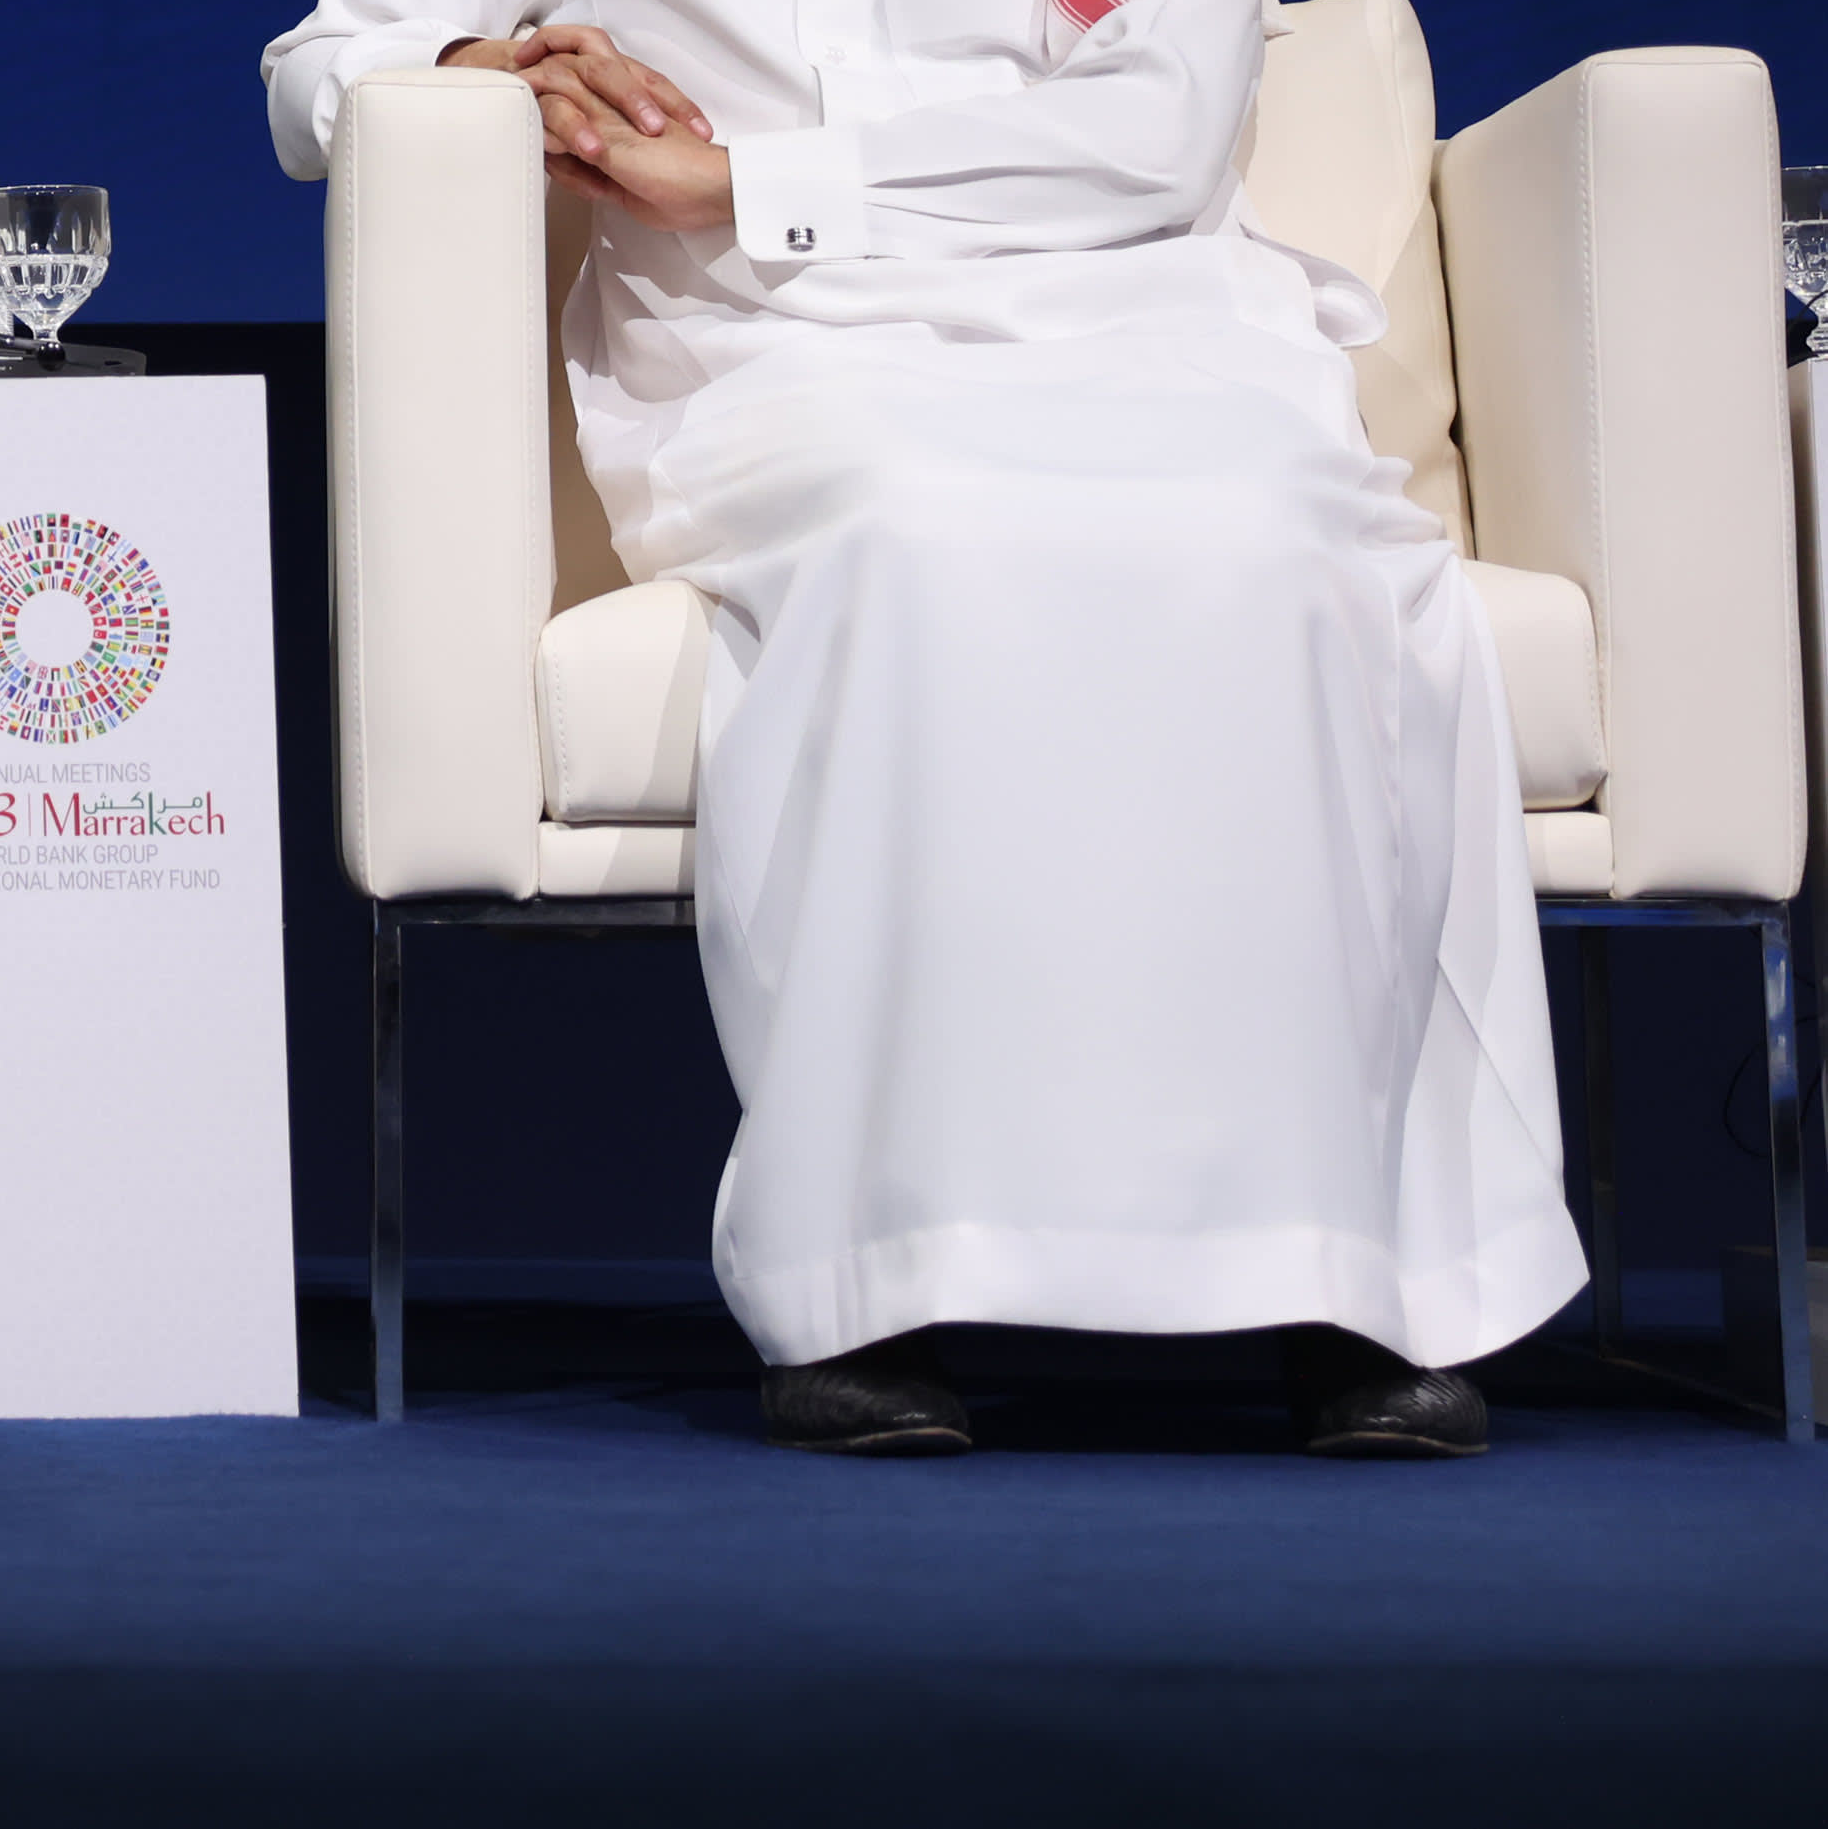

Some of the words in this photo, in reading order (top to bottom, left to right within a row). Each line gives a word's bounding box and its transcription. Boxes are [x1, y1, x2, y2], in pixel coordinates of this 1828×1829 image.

[51, 762, 151, 784] MEETINGS
[41, 790, 225, 837] Marrakech
[36, 845, 88, 865] BANK
[93, 843, 159, 865] GROUP
[58, 869, 164, 890] MONETARY
[169, 868, 220, 890] FUND
